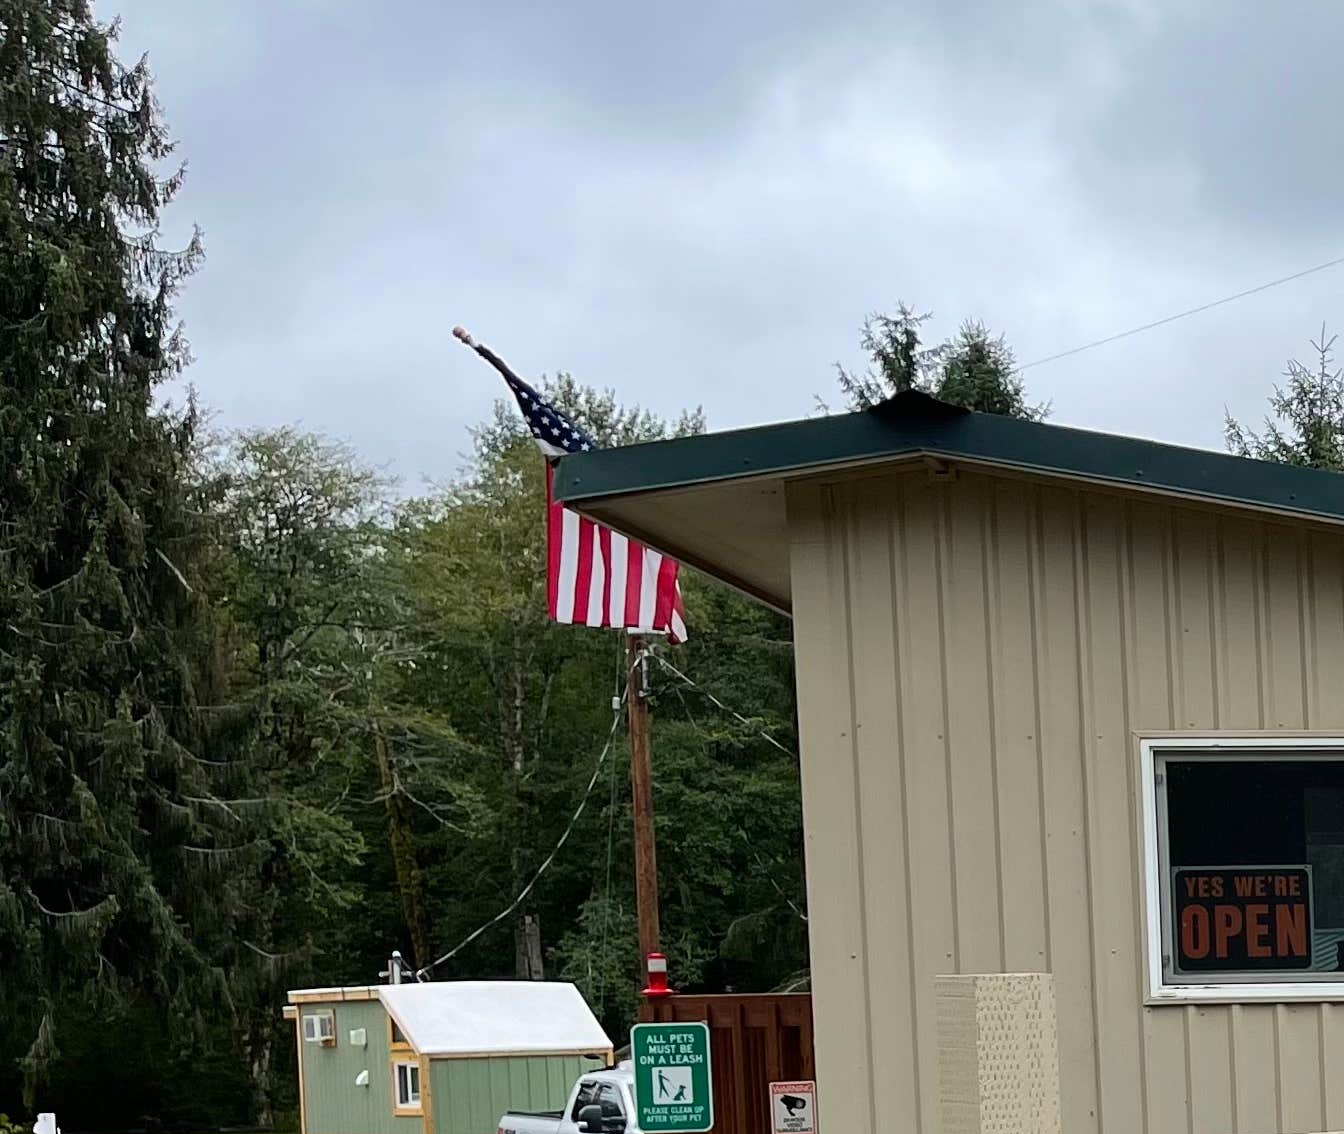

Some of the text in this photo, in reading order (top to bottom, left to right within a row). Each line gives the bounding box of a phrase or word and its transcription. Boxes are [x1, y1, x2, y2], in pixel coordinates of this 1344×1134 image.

[1183, 875, 1301, 898] YES WE'RE
[1180, 903, 1308, 960] OPEN
[646, 1033, 695, 1045] ALL PETS
[648, 1043, 694, 1055] MUST BE
[639, 1054, 703, 1065] ON A LEASH
[643, 1106, 669, 1115] PLEASE
[670, 1106, 693, 1114] CLEAN
[646, 1114, 702, 1123] AFTER YOUR PET
